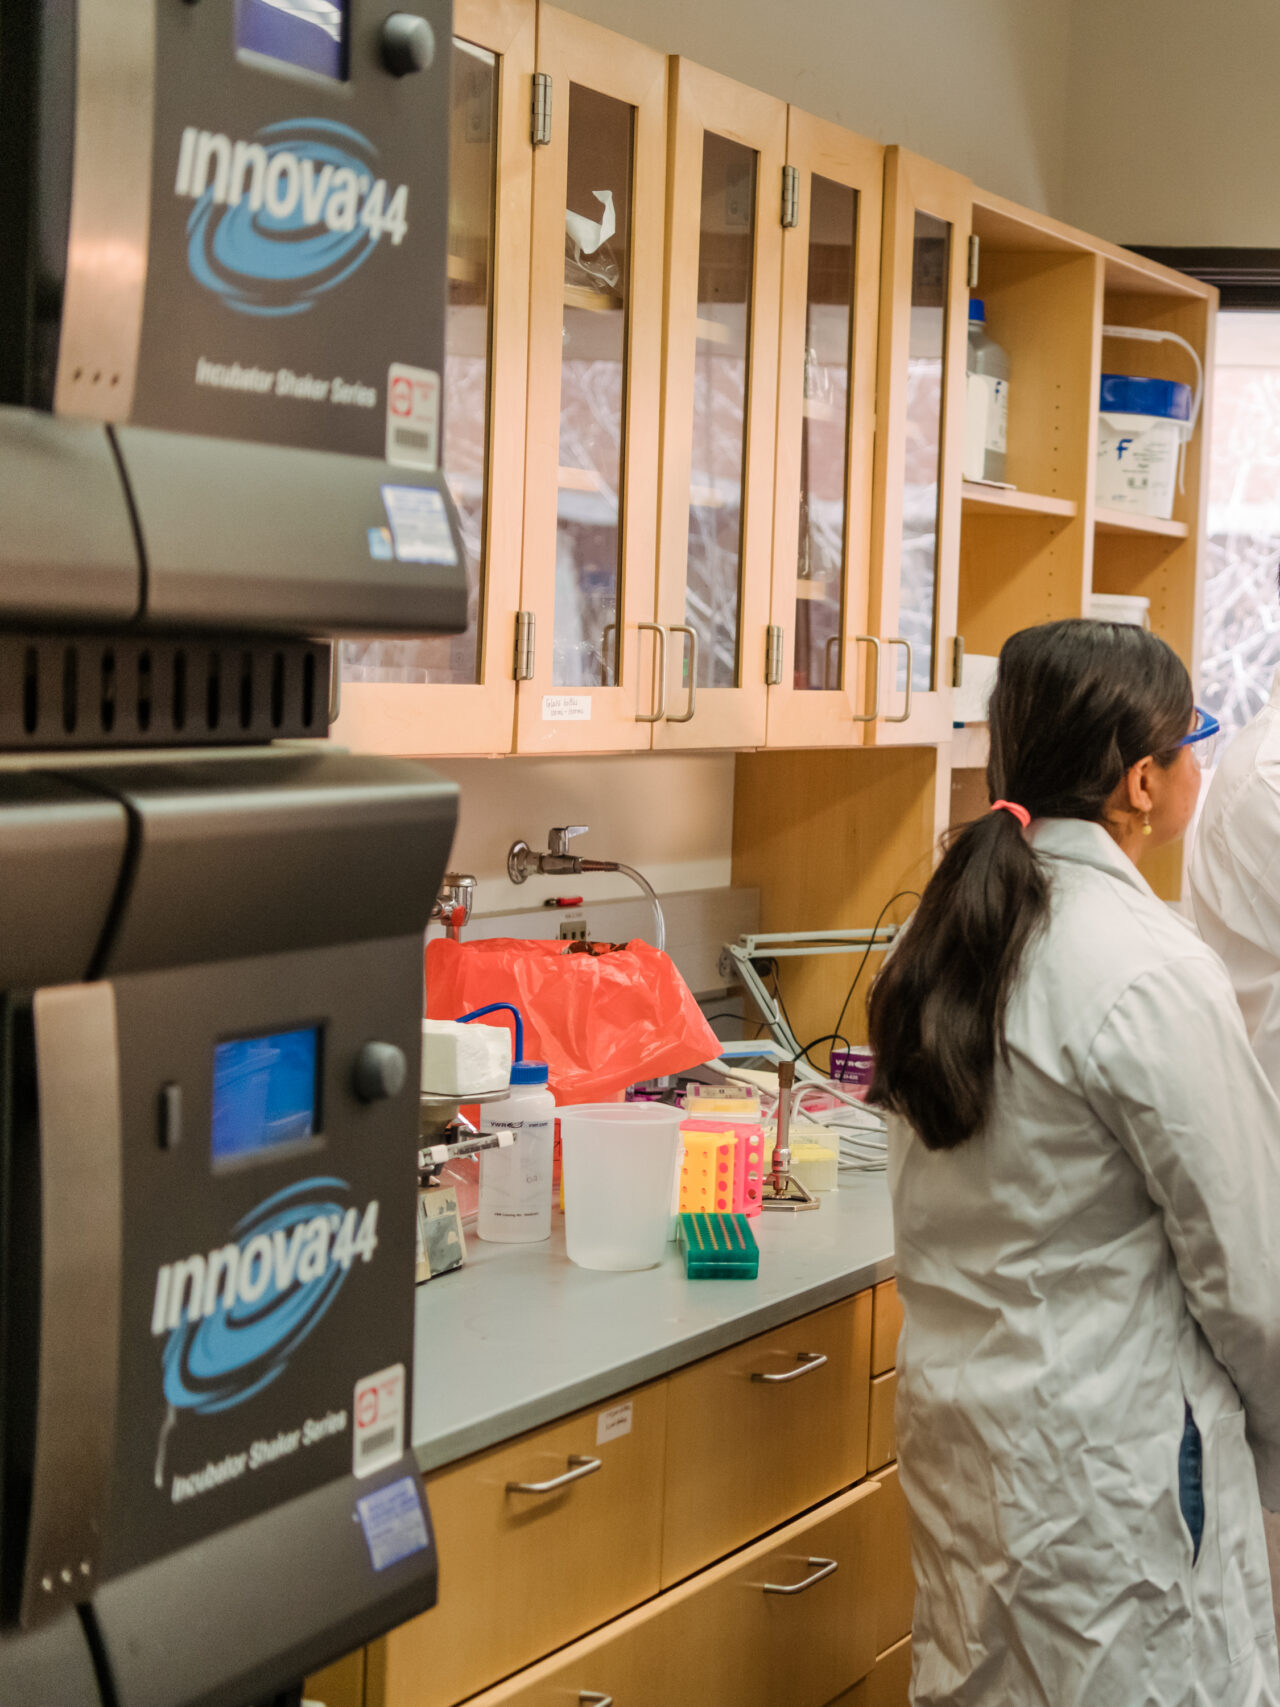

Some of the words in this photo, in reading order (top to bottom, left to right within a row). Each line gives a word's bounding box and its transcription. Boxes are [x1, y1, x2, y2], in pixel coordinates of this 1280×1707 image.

[195, 356, 275, 394] Incubator
[275, 367, 330, 402] Shaker
[330, 375, 377, 408] Series
[171, 1451, 248, 1504] Incubator
[248, 1429, 301, 1470] Shaker
[302, 1409, 349, 1447] Series
